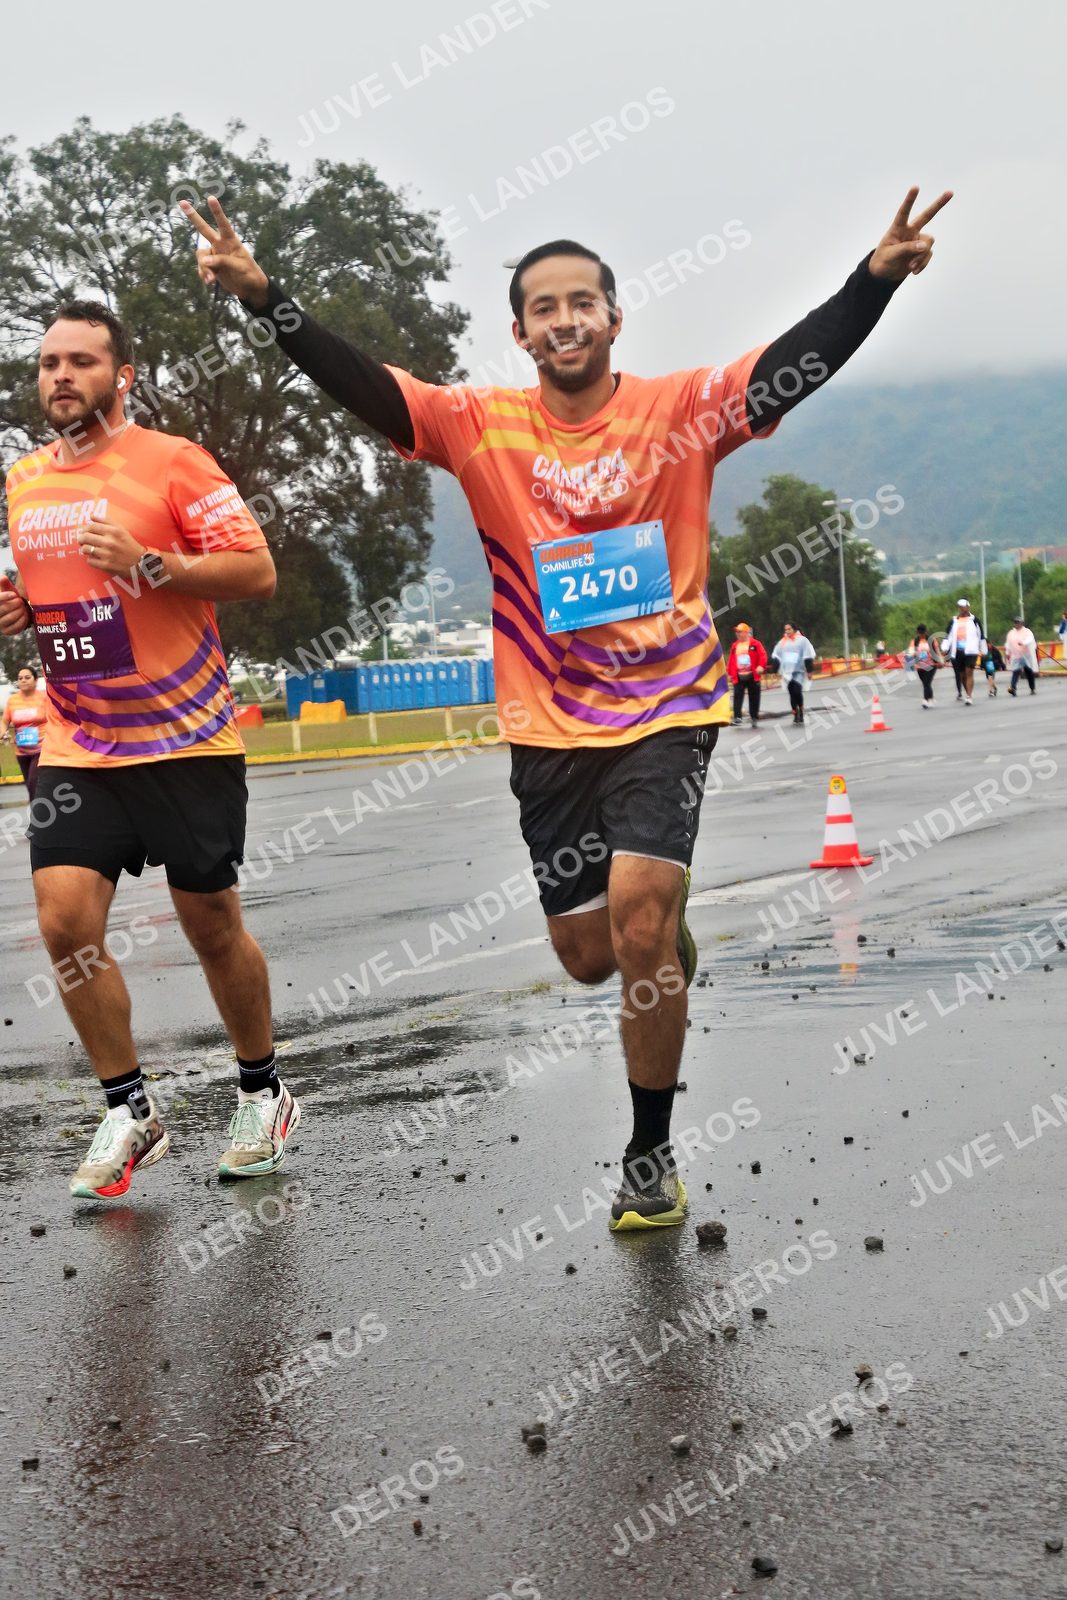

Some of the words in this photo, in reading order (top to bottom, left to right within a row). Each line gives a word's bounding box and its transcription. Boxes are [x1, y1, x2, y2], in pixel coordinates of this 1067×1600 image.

[532, 447, 627, 491] CARRERA
[18, 499, 108, 532] CARRERA
[540, 541, 594, 563] CARRERA
[559, 565, 638, 603] 2470
[91, 605, 113, 623] 15K
[53, 636, 96, 662] 515
